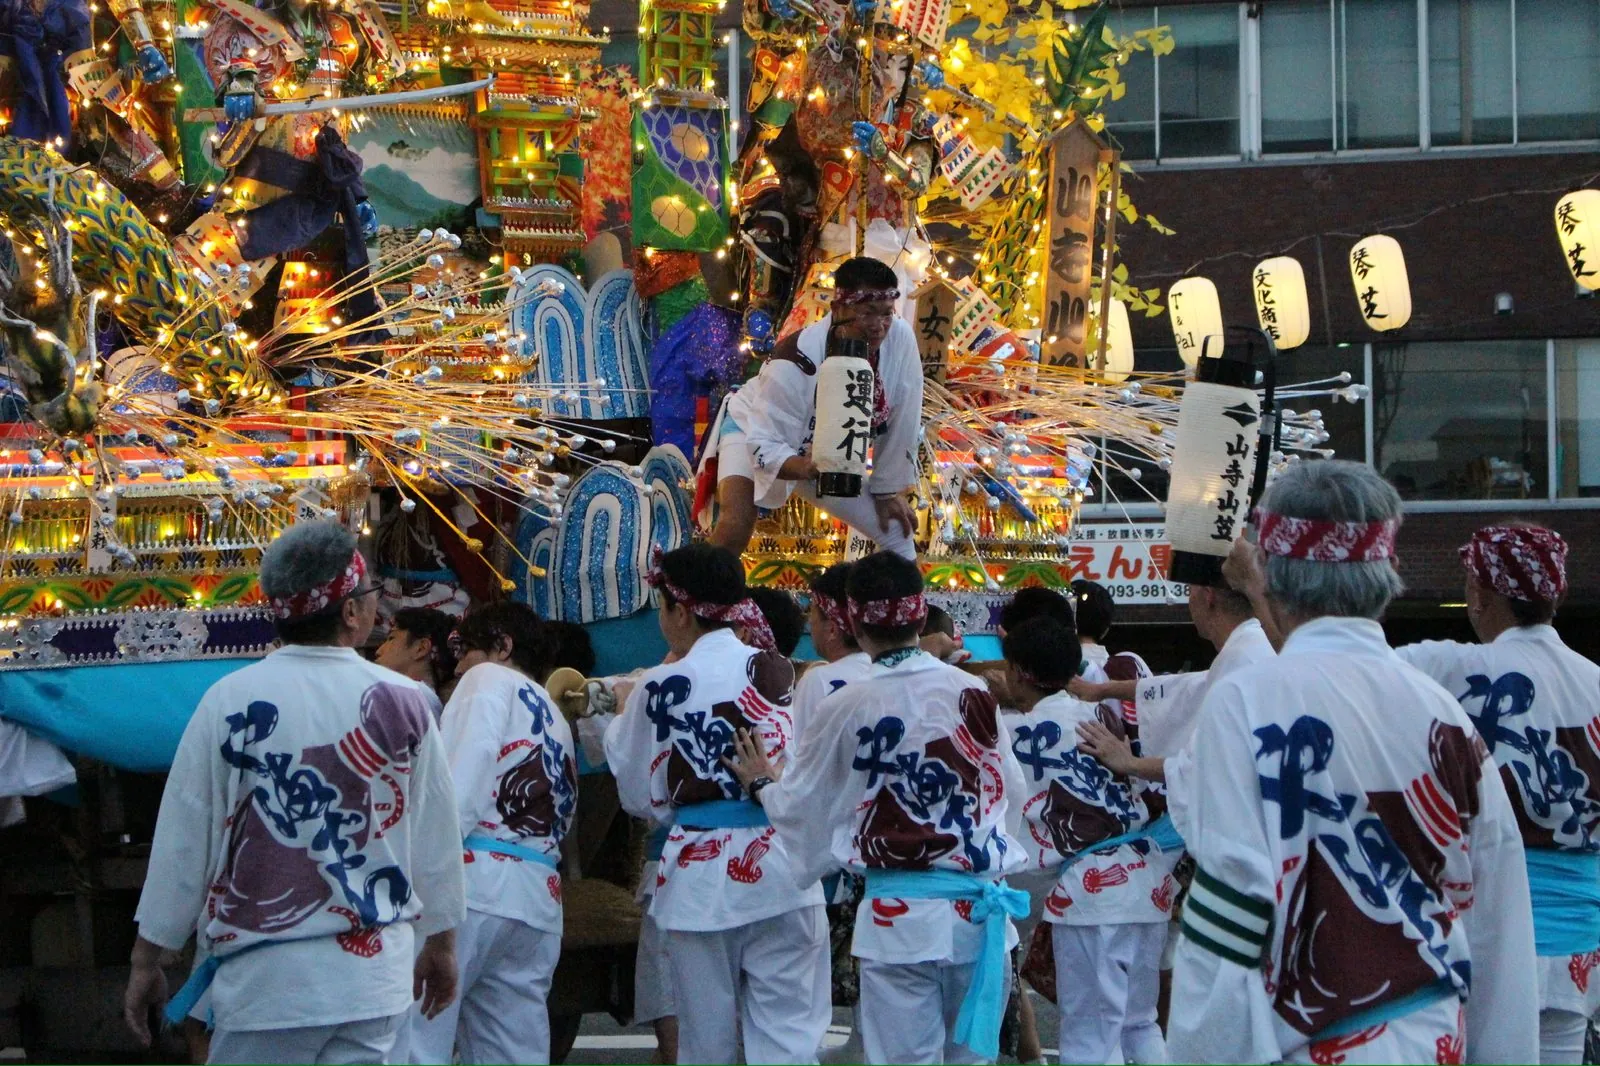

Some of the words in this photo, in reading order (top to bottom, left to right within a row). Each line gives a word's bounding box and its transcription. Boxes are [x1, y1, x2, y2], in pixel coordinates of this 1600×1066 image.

[835, 368, 875, 463] 運行
[1210, 433, 1250, 543] 山寺山笠
